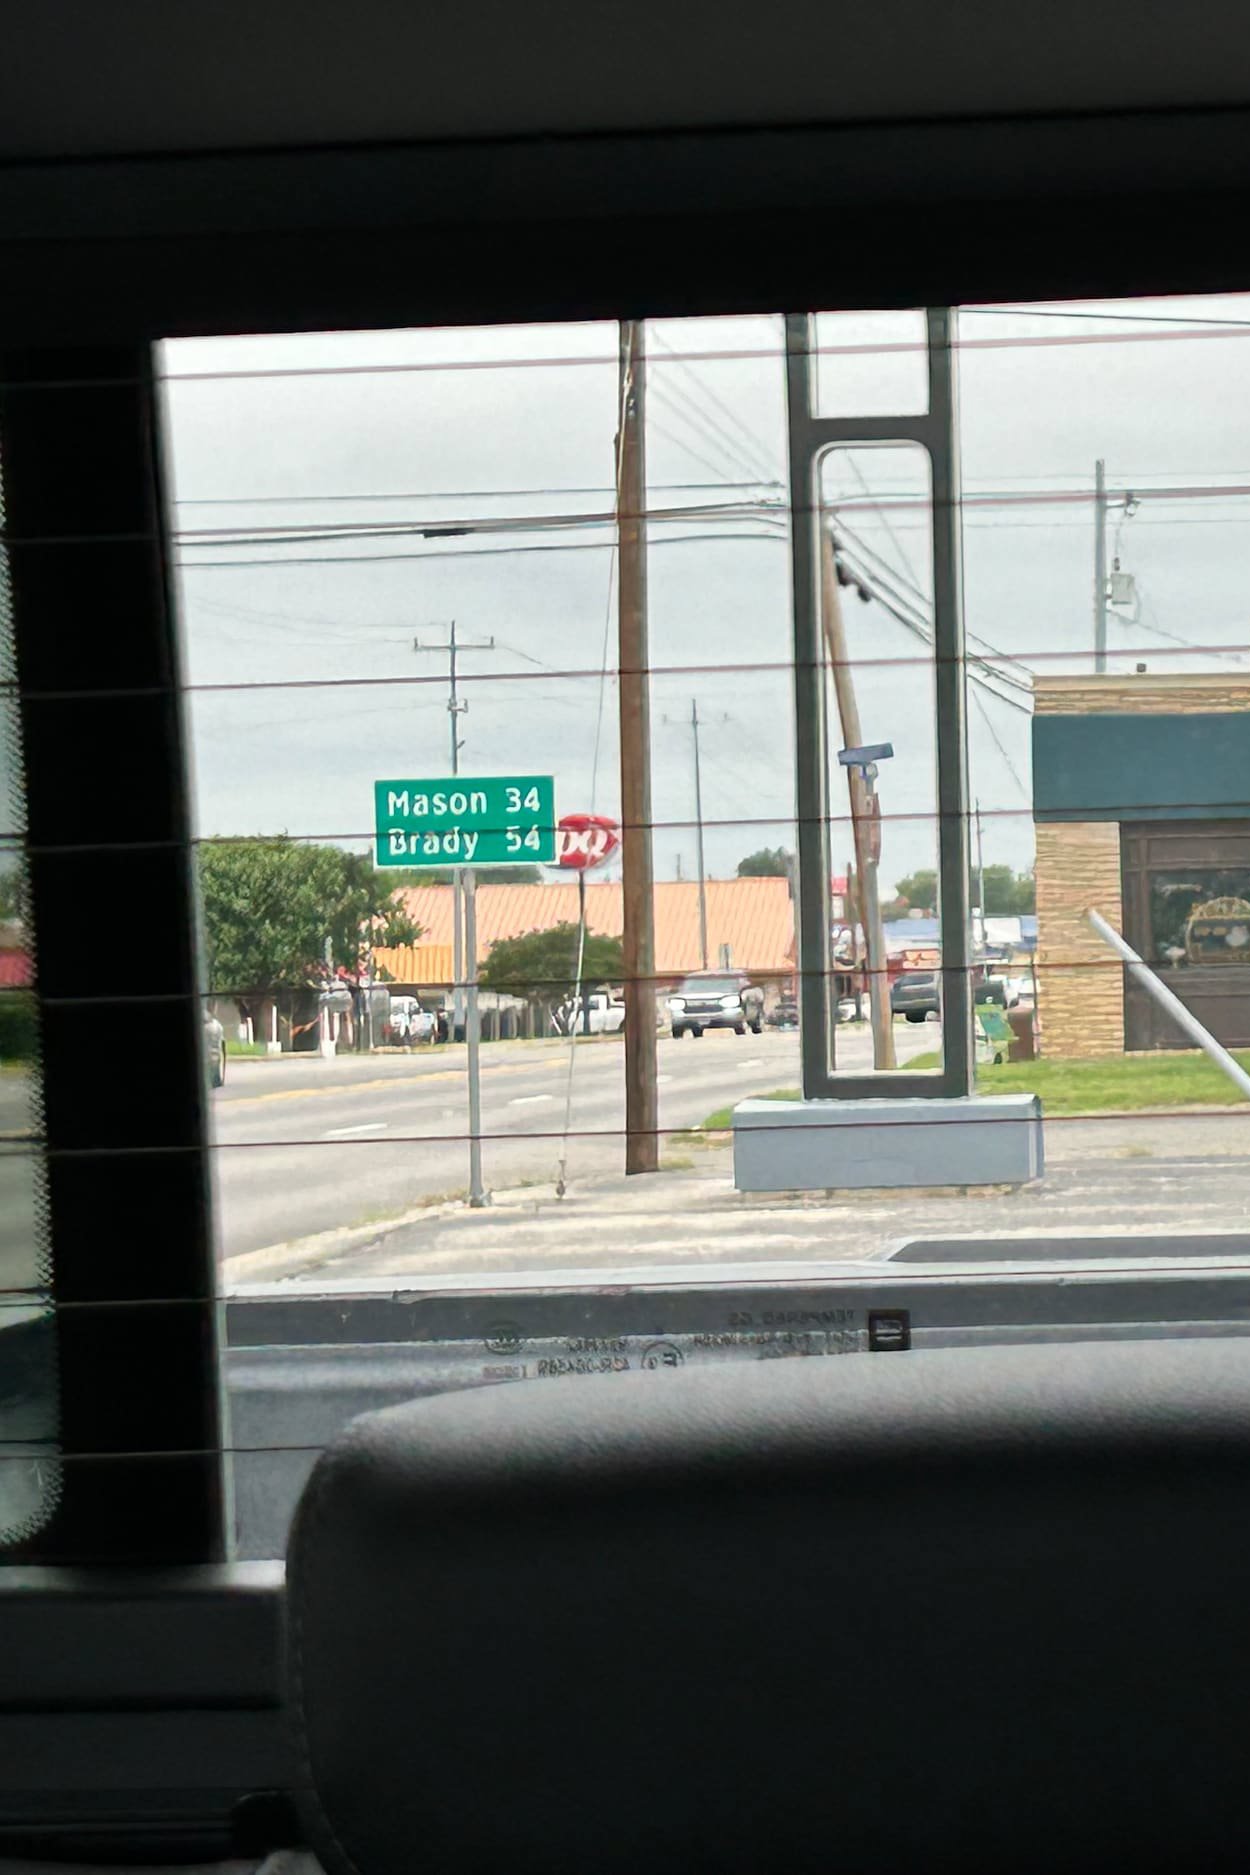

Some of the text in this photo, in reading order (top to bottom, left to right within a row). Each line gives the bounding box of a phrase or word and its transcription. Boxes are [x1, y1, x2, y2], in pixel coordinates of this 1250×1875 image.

[387, 786, 541, 817] Mason 34
[388, 825, 541, 861] Brady 54
[558, 829, 607, 857] DQ
